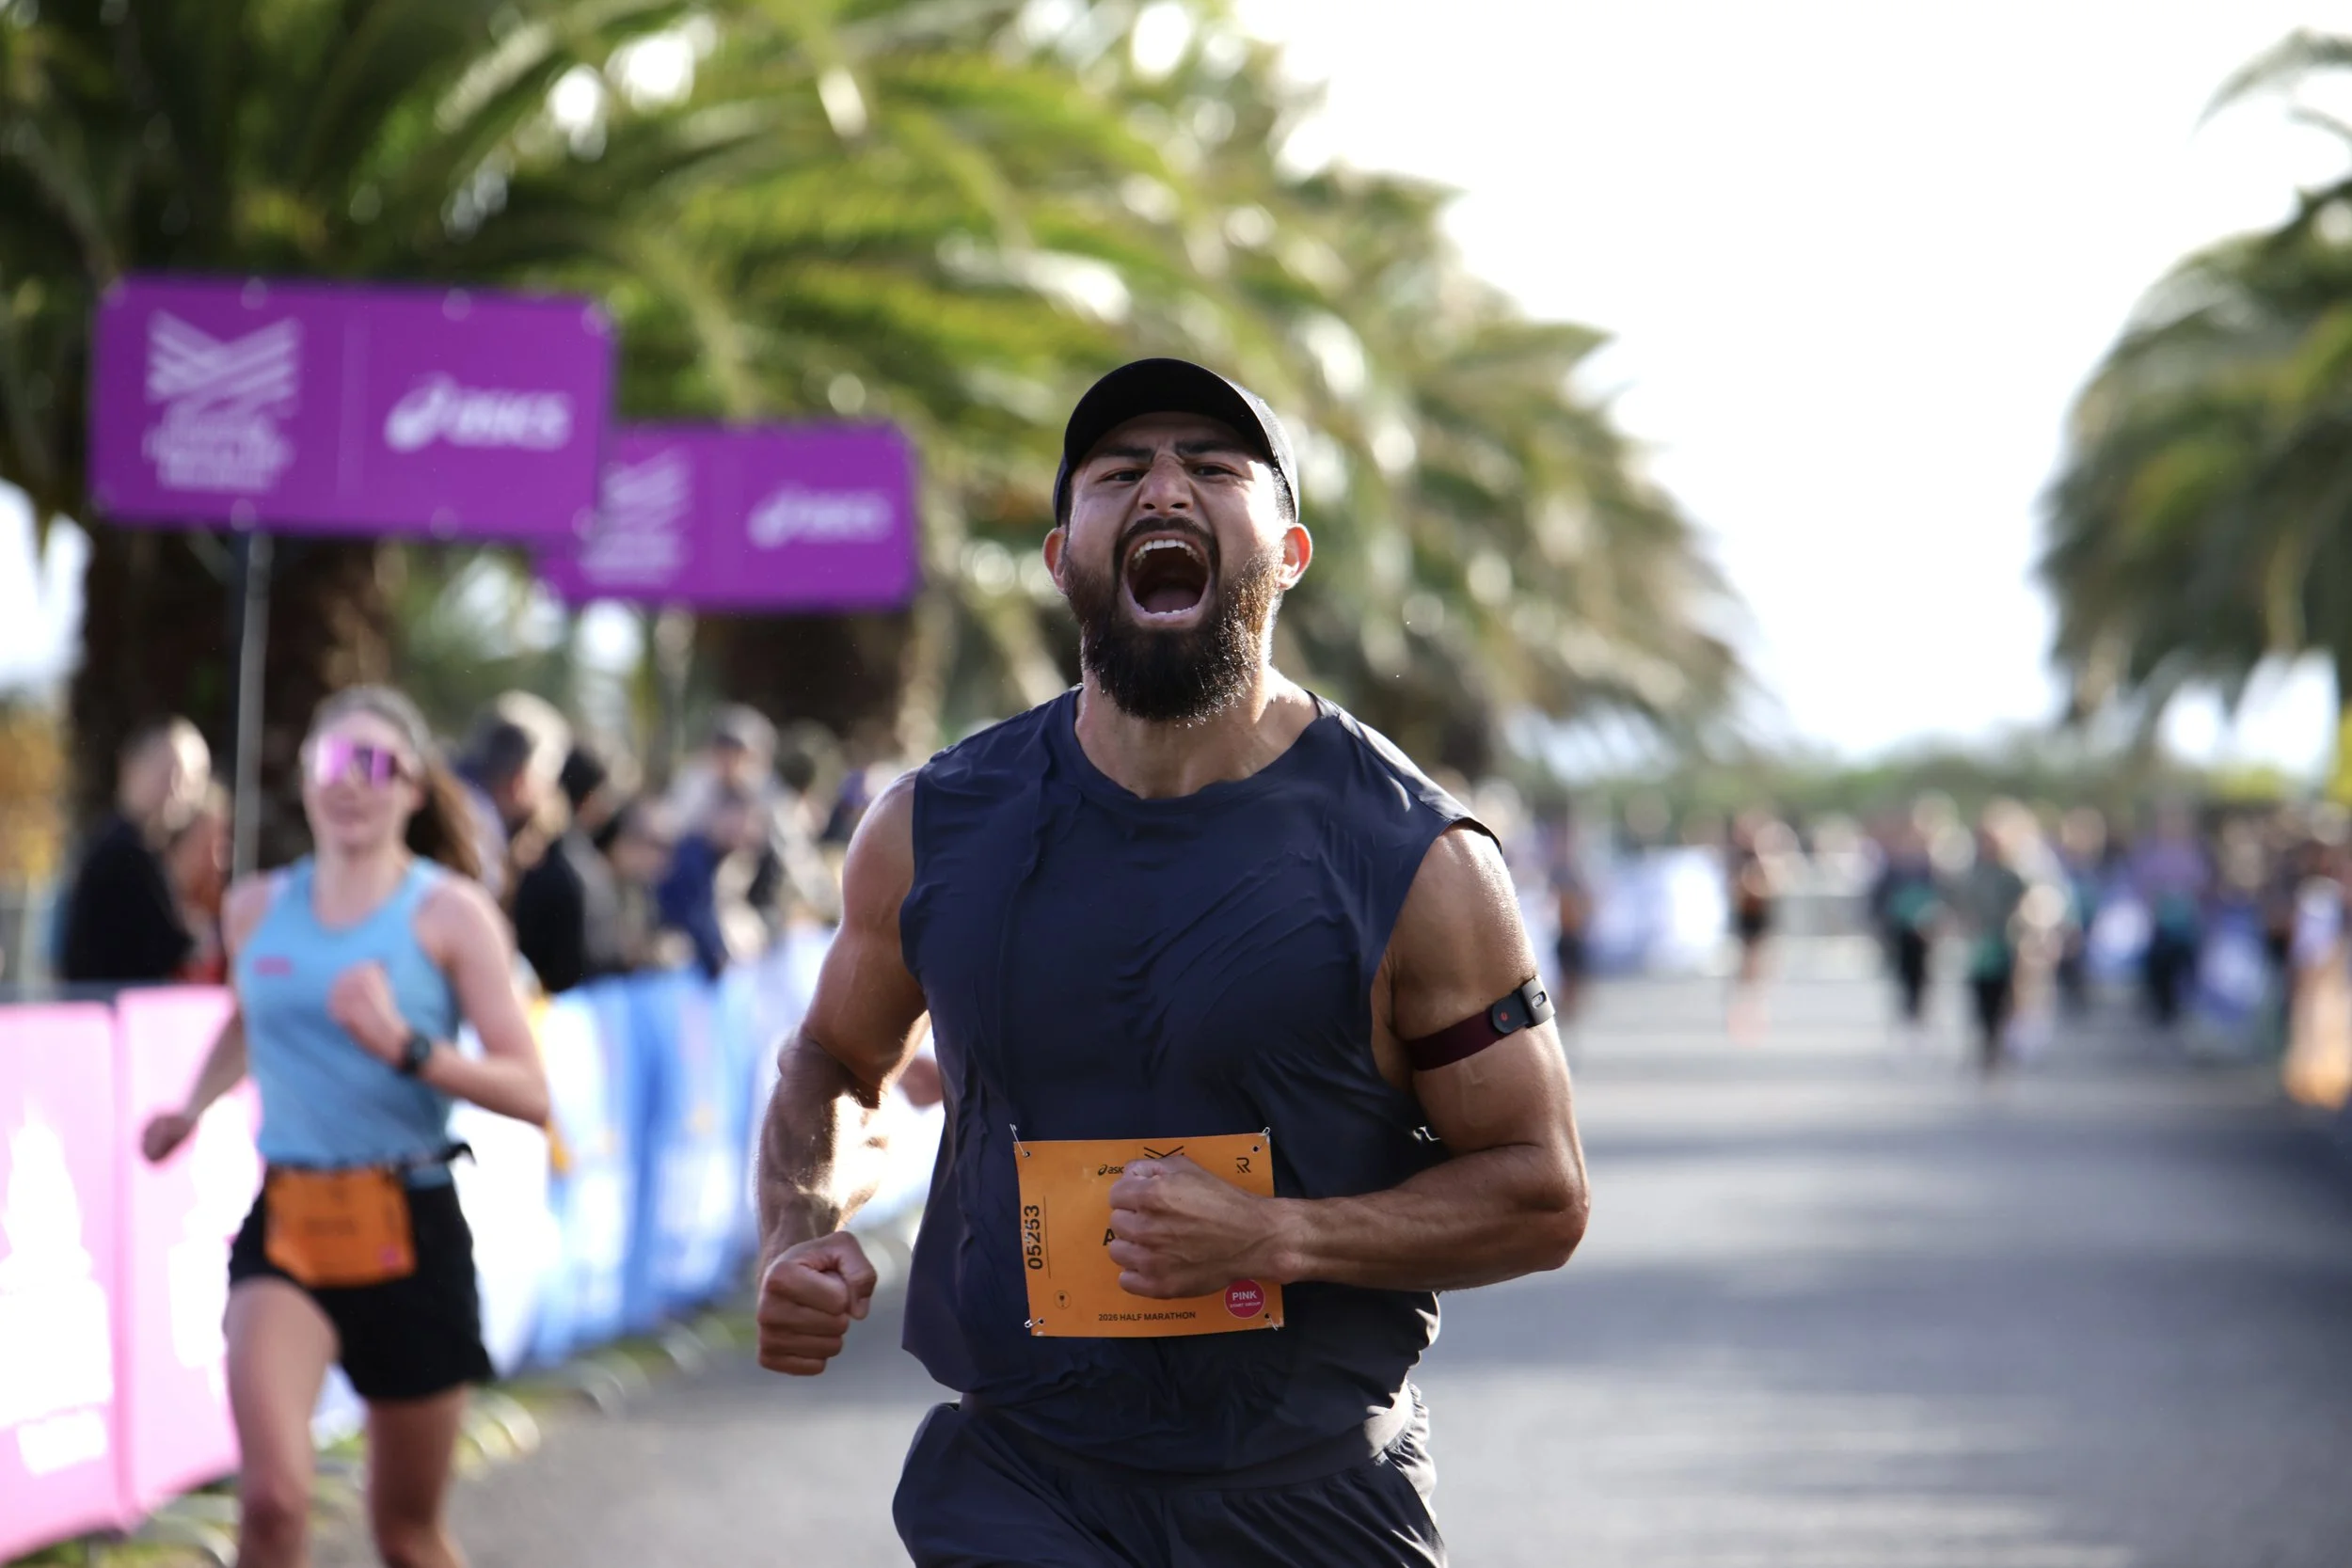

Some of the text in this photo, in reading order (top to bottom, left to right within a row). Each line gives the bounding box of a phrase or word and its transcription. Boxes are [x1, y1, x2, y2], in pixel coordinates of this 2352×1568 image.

[1024, 1205, 1043, 1270] 05253
[1232, 1291, 1258, 1301] PINK
[1098, 1311, 1197, 1322] 2026 HALF MARATHON
